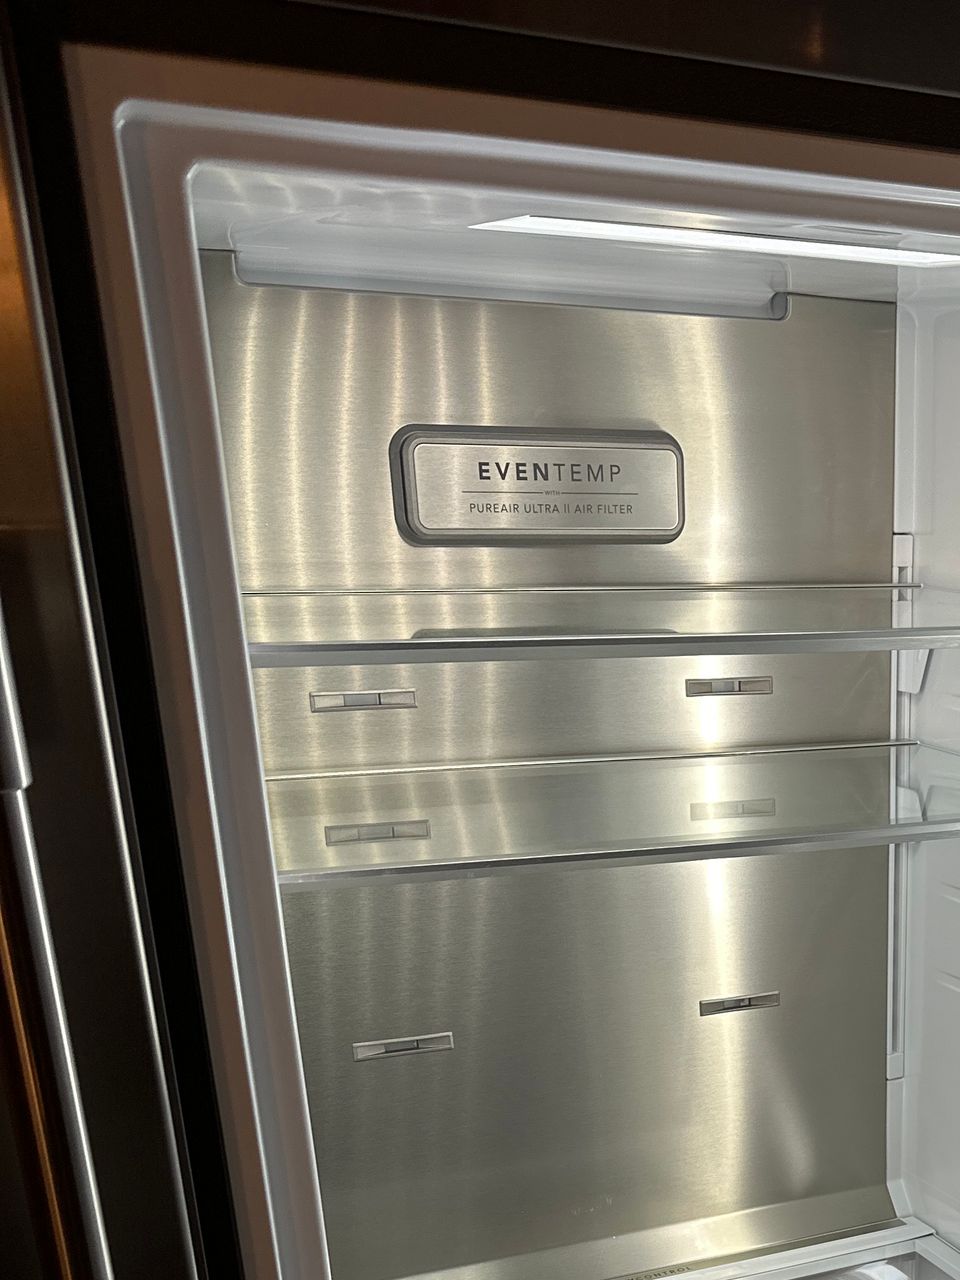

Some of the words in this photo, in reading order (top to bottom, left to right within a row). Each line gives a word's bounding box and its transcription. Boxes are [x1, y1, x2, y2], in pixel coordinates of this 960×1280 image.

[478, 461, 621, 482] EVENTEMP
[469, 502, 520, 514] PUREAIR
[523, 503, 560, 514] ULTRA
[574, 504, 593, 514] AIR
[597, 504, 633, 514] FILTER
